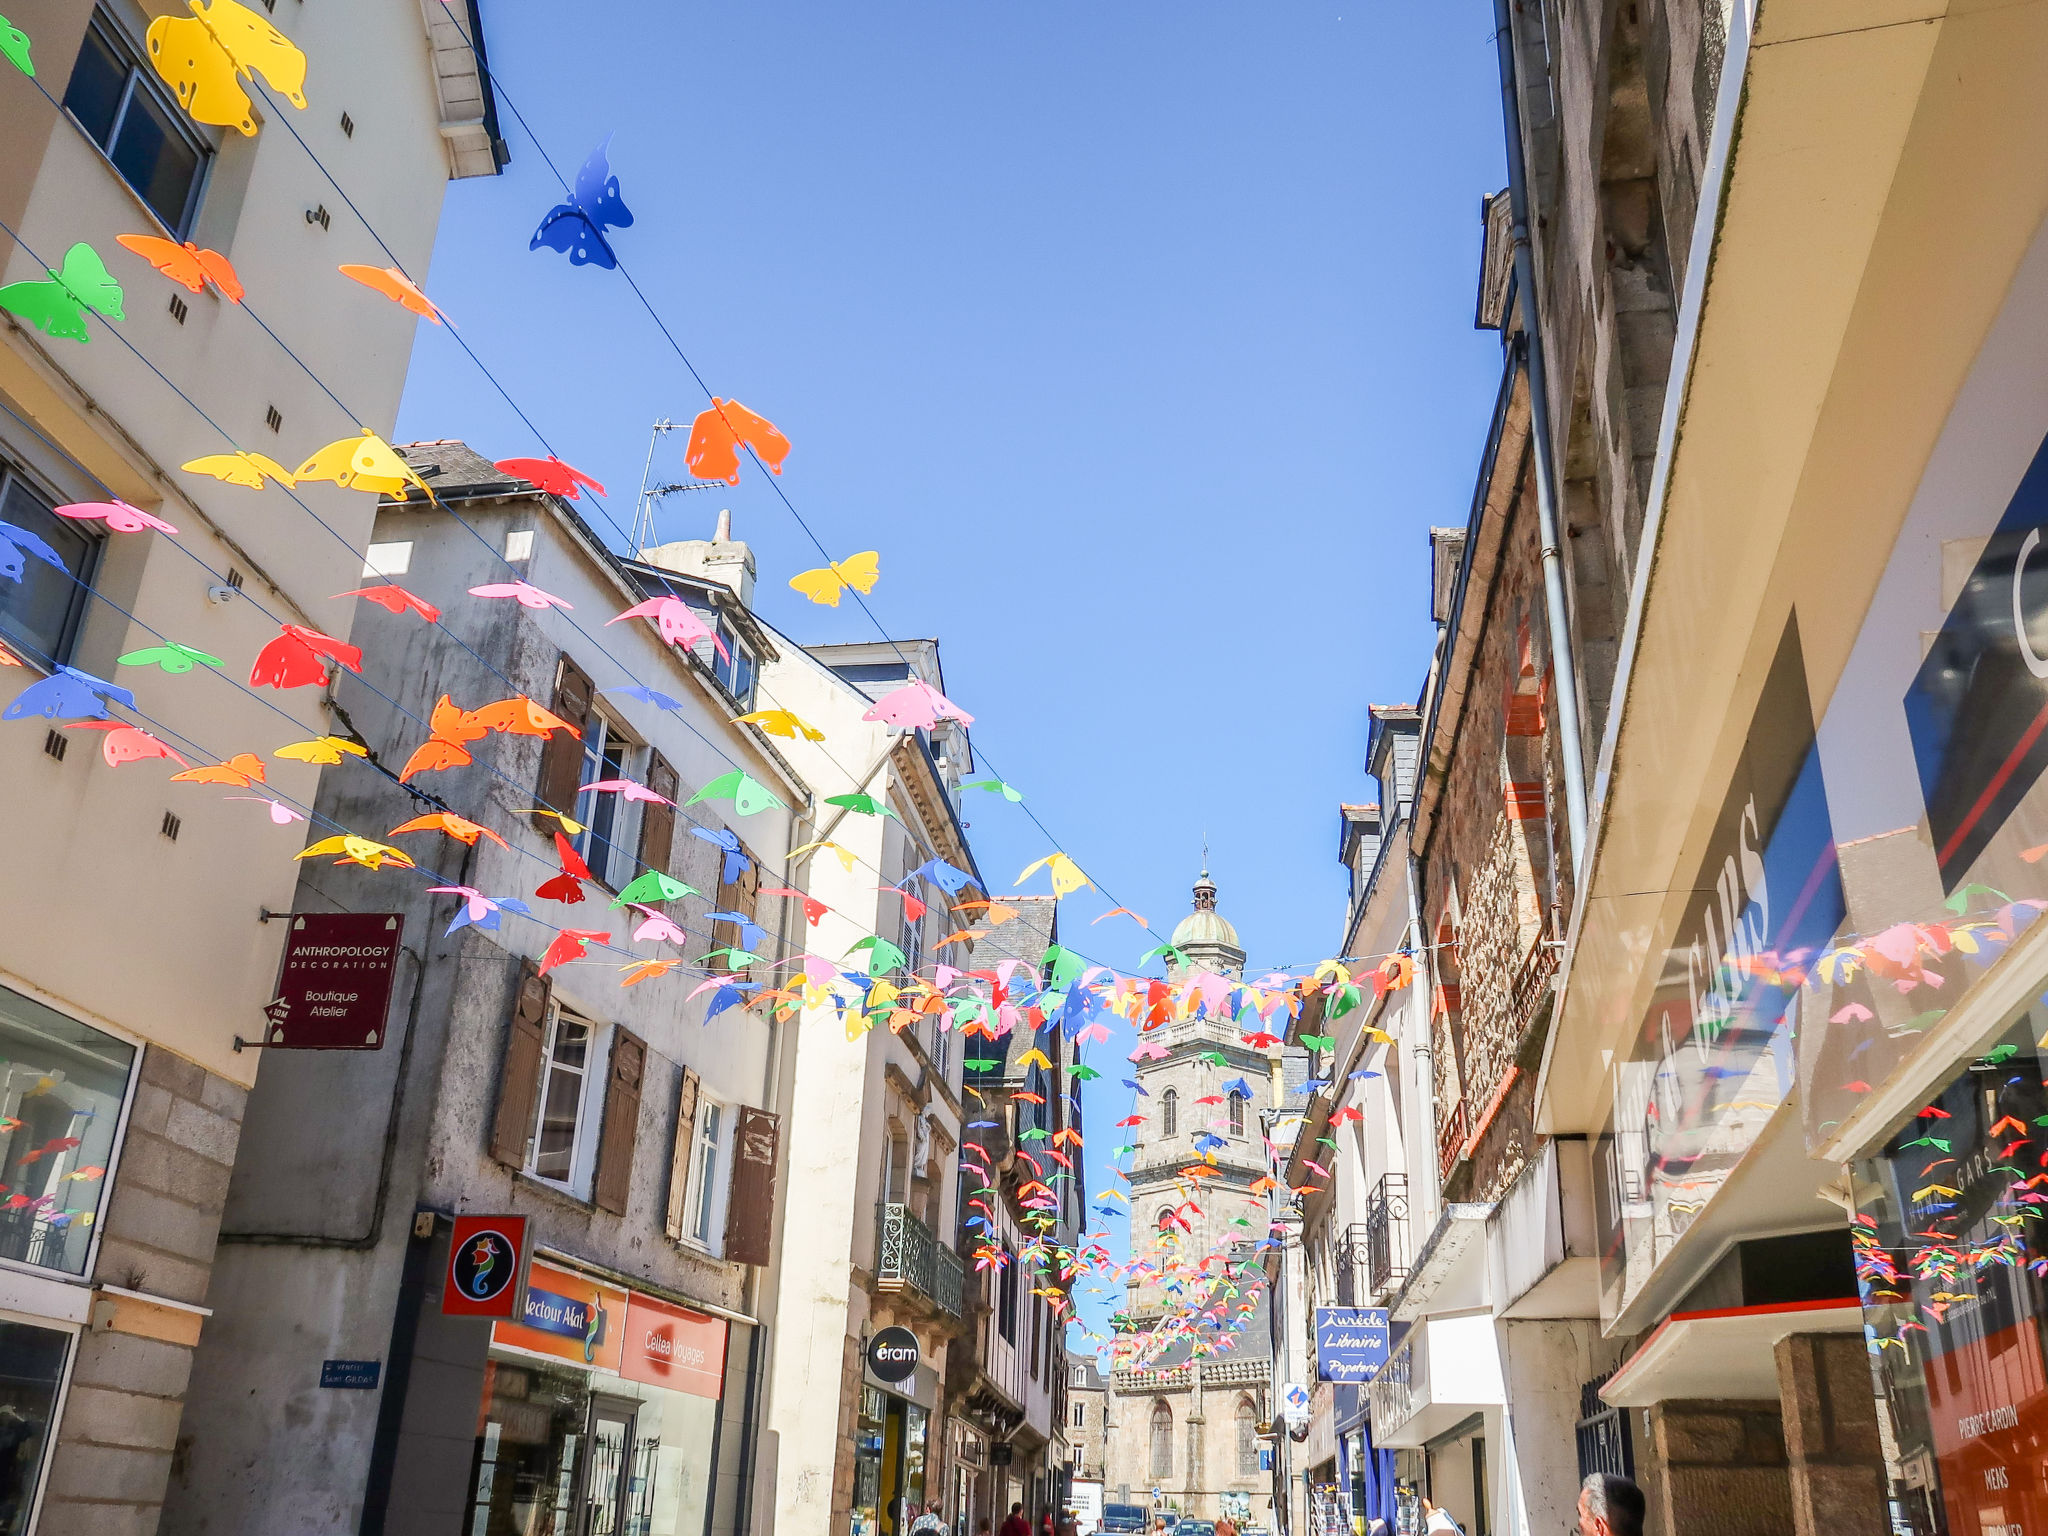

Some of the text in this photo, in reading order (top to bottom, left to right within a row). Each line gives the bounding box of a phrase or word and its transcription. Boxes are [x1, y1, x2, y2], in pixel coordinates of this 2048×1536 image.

[292, 946, 389, 957] ANTHROPOLOGY
[290, 961, 387, 969] DECORATION
[305, 990, 358, 1002] Boutique
[273, 1008, 288, 1018] 10M
[310, 1006, 348, 1017] Atelier
[1956, 1146, 1993, 1191] GARS
[525, 1294, 562, 1323] lectour
[645, 1330, 705, 1365] Celtea Voyages
[876, 1341, 917, 1361] éram
[1323, 1333, 1382, 1349] Librairie
[1328, 1359, 1379, 1379] Papeterie
[1958, 1404, 2019, 1440] PIERRE CARDIN
[1983, 1466, 2009, 1491] MENS
